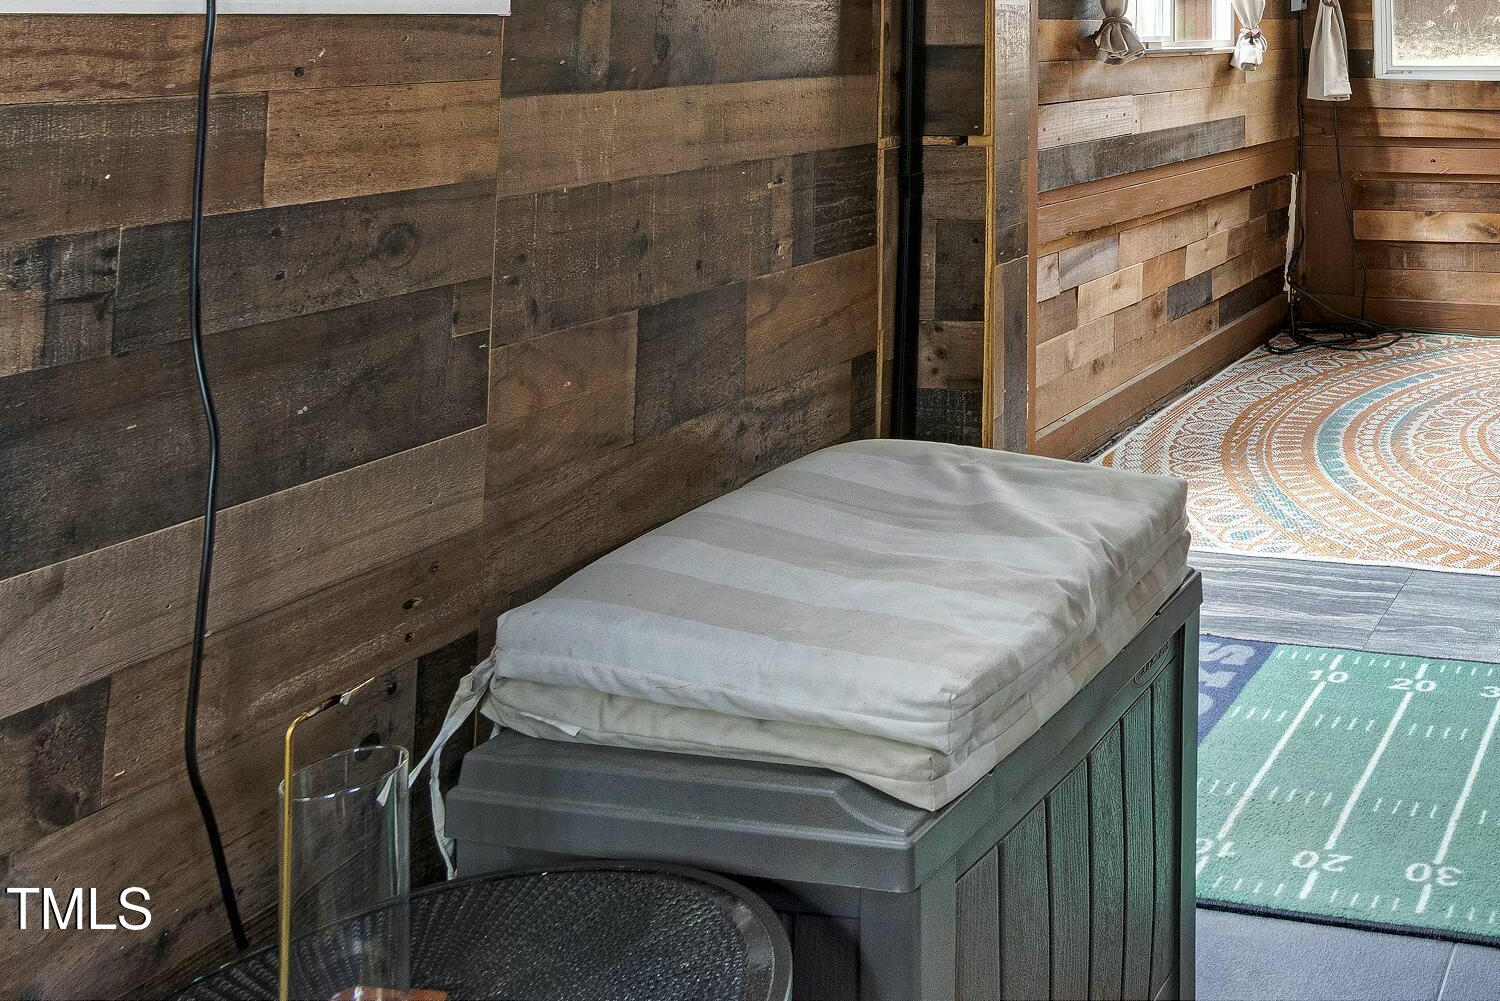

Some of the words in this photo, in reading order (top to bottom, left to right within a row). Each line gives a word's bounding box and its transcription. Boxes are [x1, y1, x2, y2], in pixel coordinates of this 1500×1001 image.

[1310, 669, 1349, 684] 10
[1387, 678, 1438, 693] 20
[1292, 850, 1352, 871] 20
[1405, 862, 1461, 885] 30
